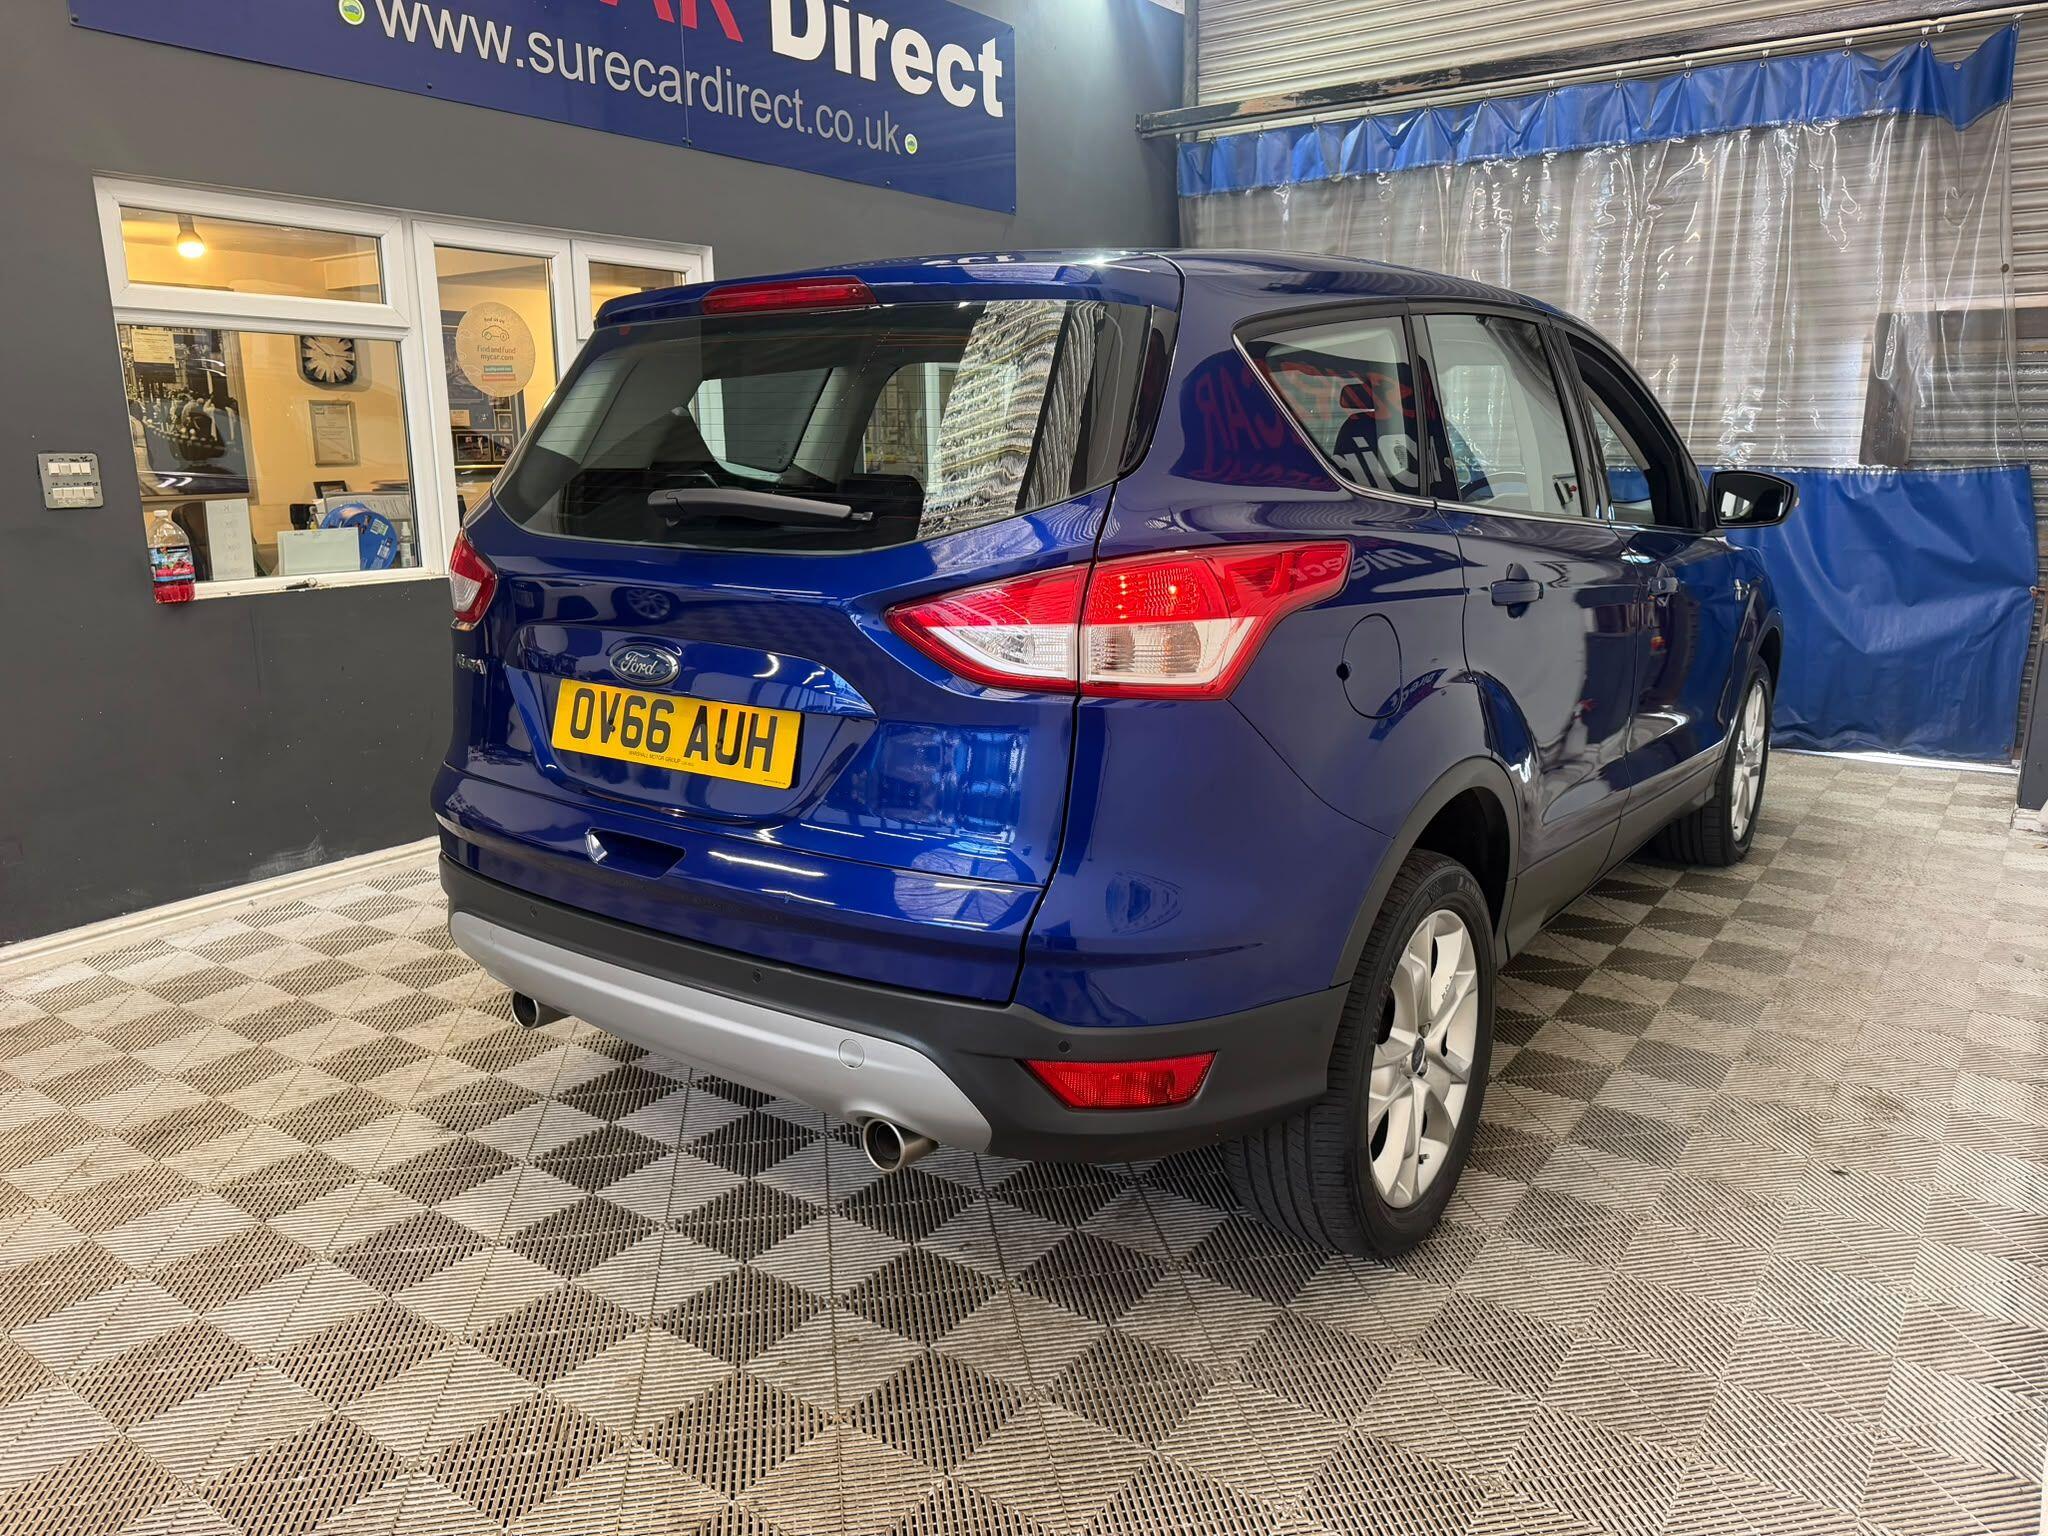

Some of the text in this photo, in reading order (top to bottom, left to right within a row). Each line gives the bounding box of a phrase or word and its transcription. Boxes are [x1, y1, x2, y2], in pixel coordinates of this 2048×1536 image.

[374, 0, 901, 155] www.surecardirect.co.uk
[770, 0, 1003, 118] Direct
[620, 650, 658, 675] Ford
[570, 687, 779, 773] OV66 AUH
